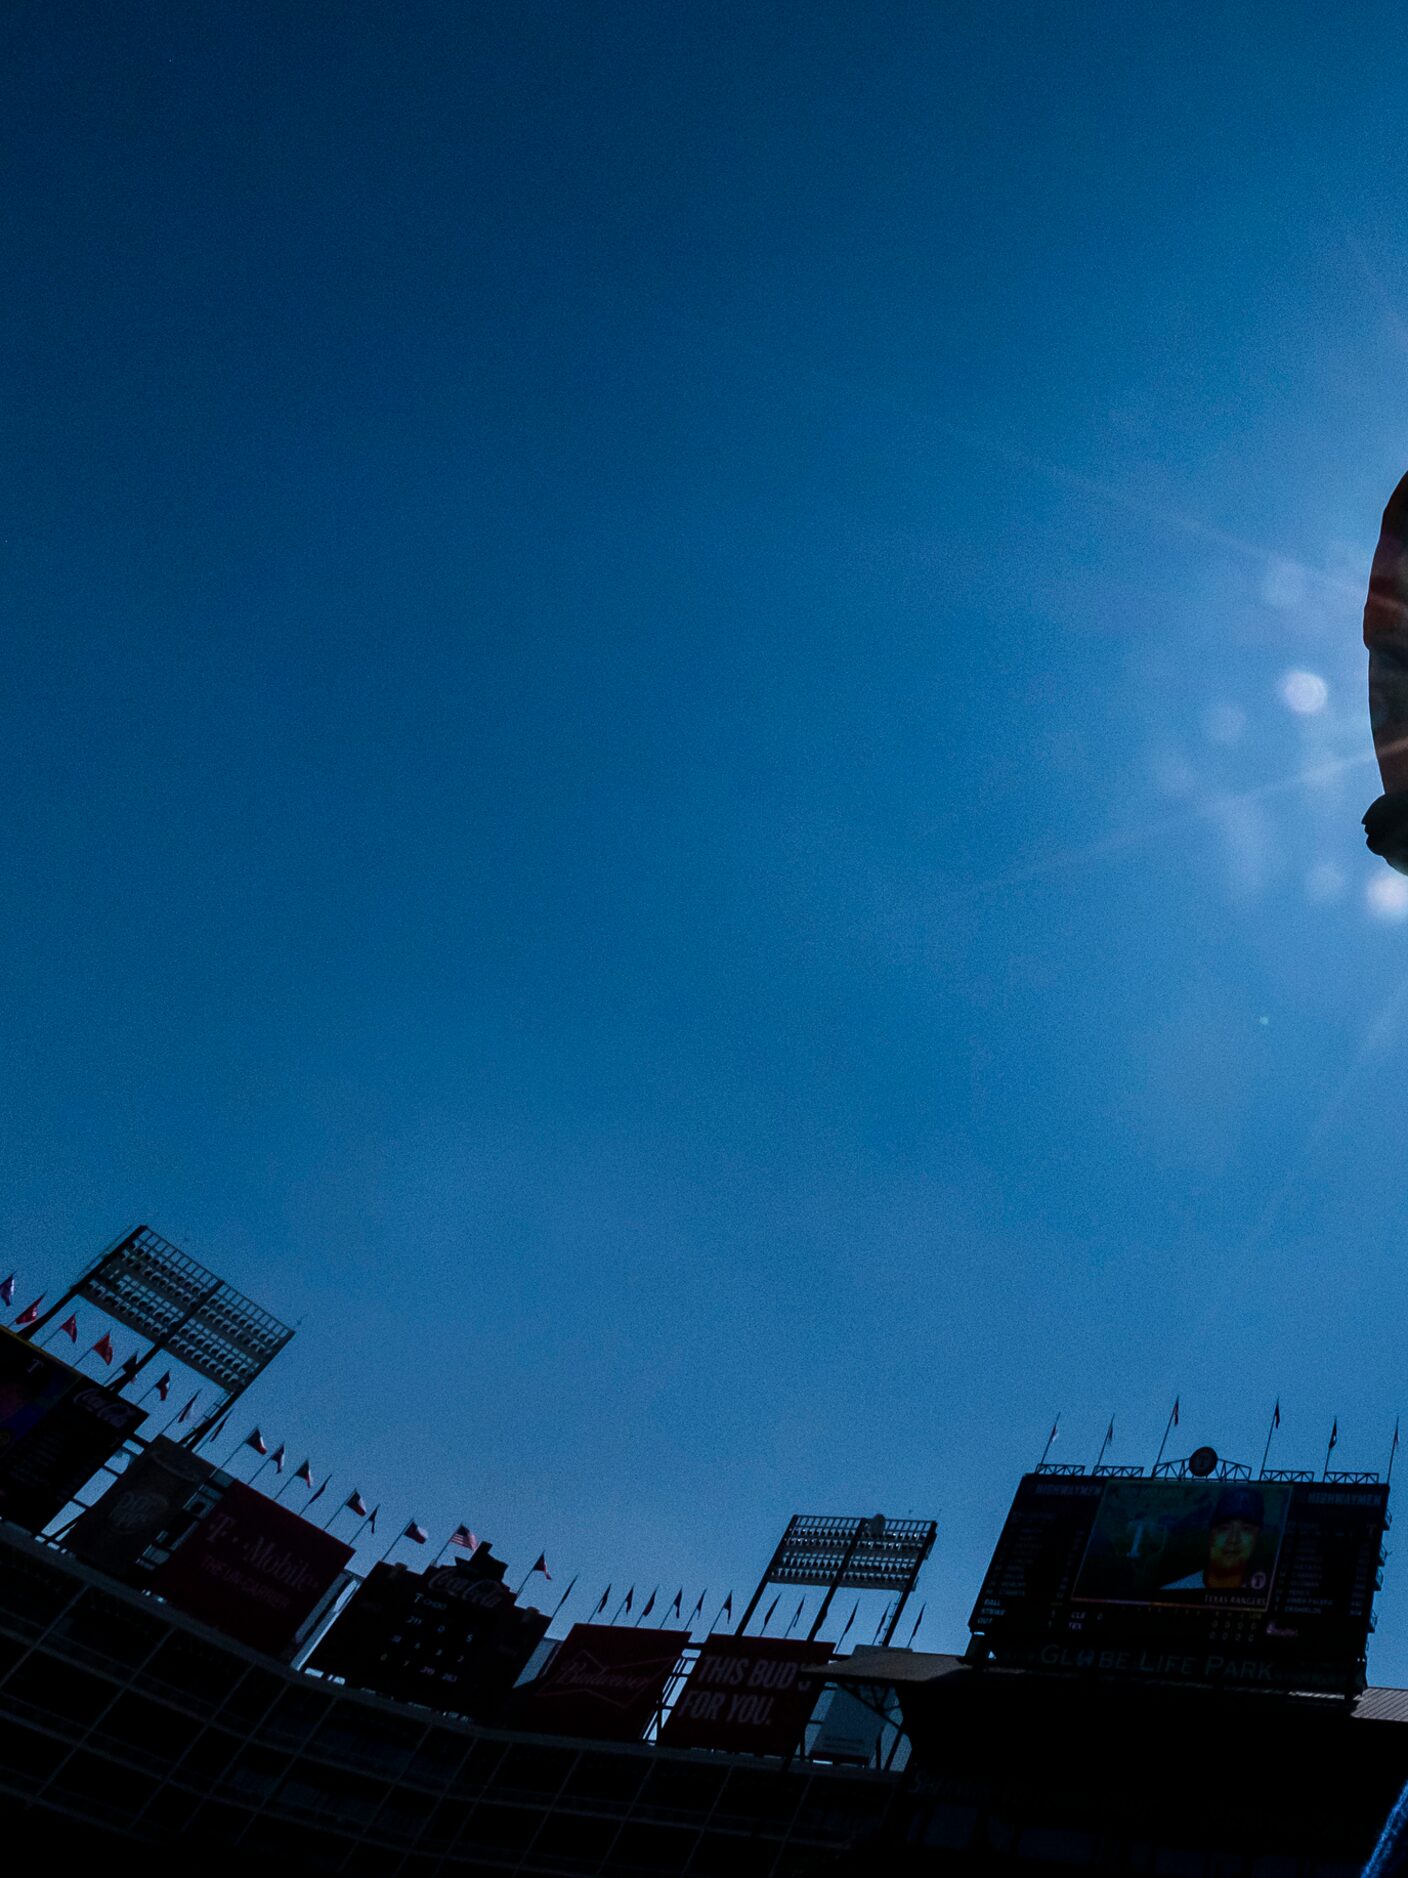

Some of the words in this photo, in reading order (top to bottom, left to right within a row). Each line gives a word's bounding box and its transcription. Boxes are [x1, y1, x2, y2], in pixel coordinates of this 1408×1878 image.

[983, 1598, 1002, 1607] BALL
[1203, 1594, 1228, 1604] TEXAS
[1229, 1595, 1267, 1607] RANGERS
[555, 1660, 653, 1692] Budweiser
[696, 1655, 748, 1686] THIS
[1040, 1643, 1131, 1671] GLOBE
[1137, 1649, 1197, 1675] LIFE
[1203, 1655, 1276, 1682] PARK
[676, 1689, 723, 1720] FOR
[723, 1692, 774, 1727] YOU.
